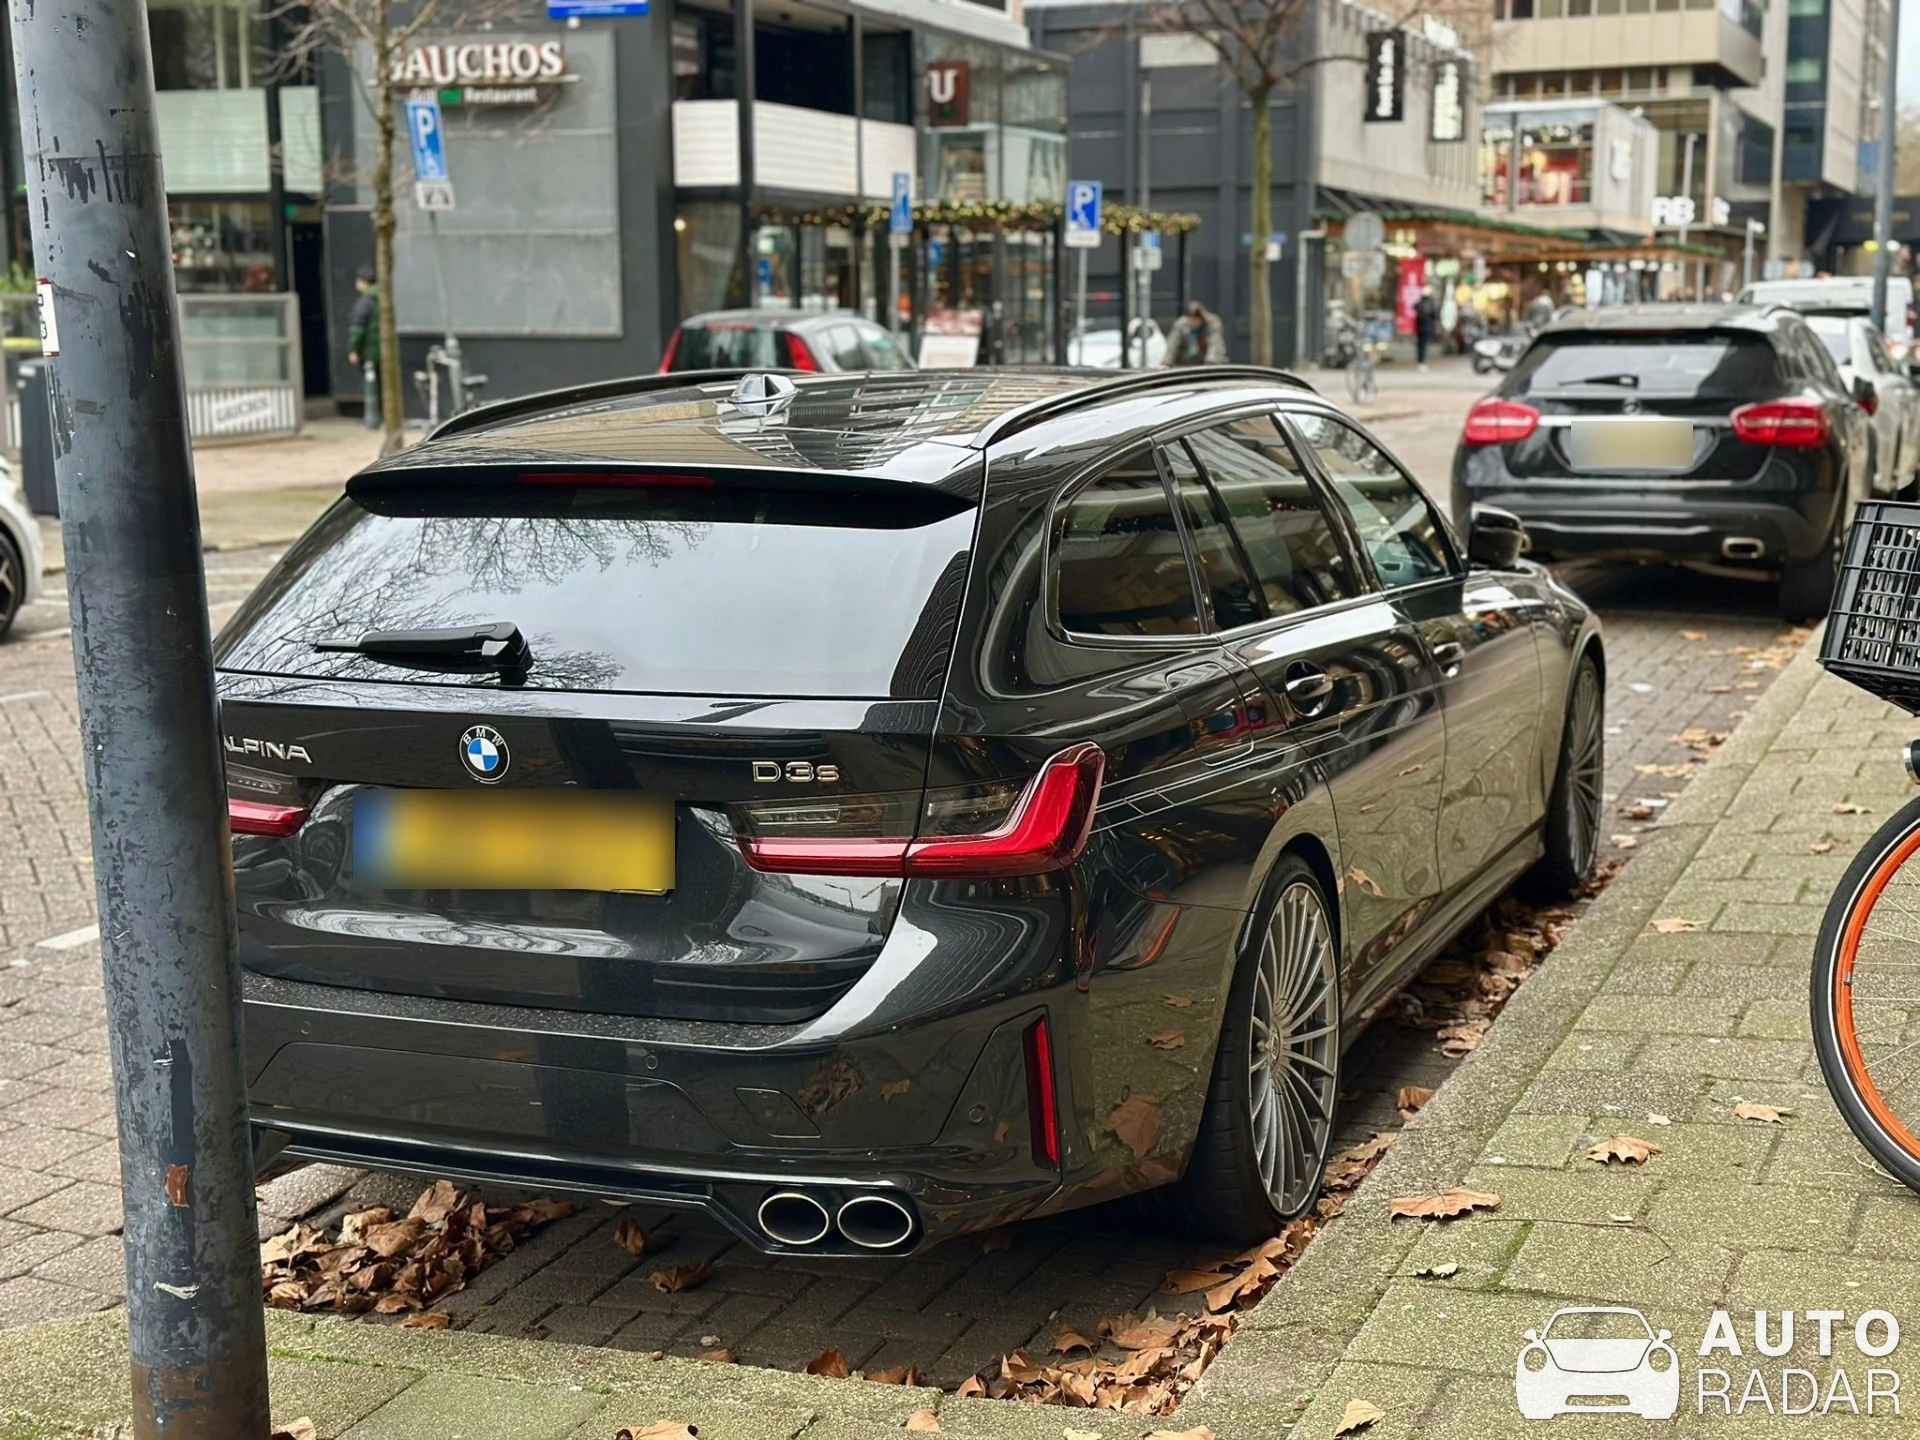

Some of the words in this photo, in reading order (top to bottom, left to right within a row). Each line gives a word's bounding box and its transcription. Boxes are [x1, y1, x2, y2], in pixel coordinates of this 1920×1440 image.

[463, 87, 537, 102] Restaurant
[928, 69, 957, 103] U
[416, 107, 435, 149] P
[1073, 185, 1094, 213] P
[463, 727, 503, 746] BMW
